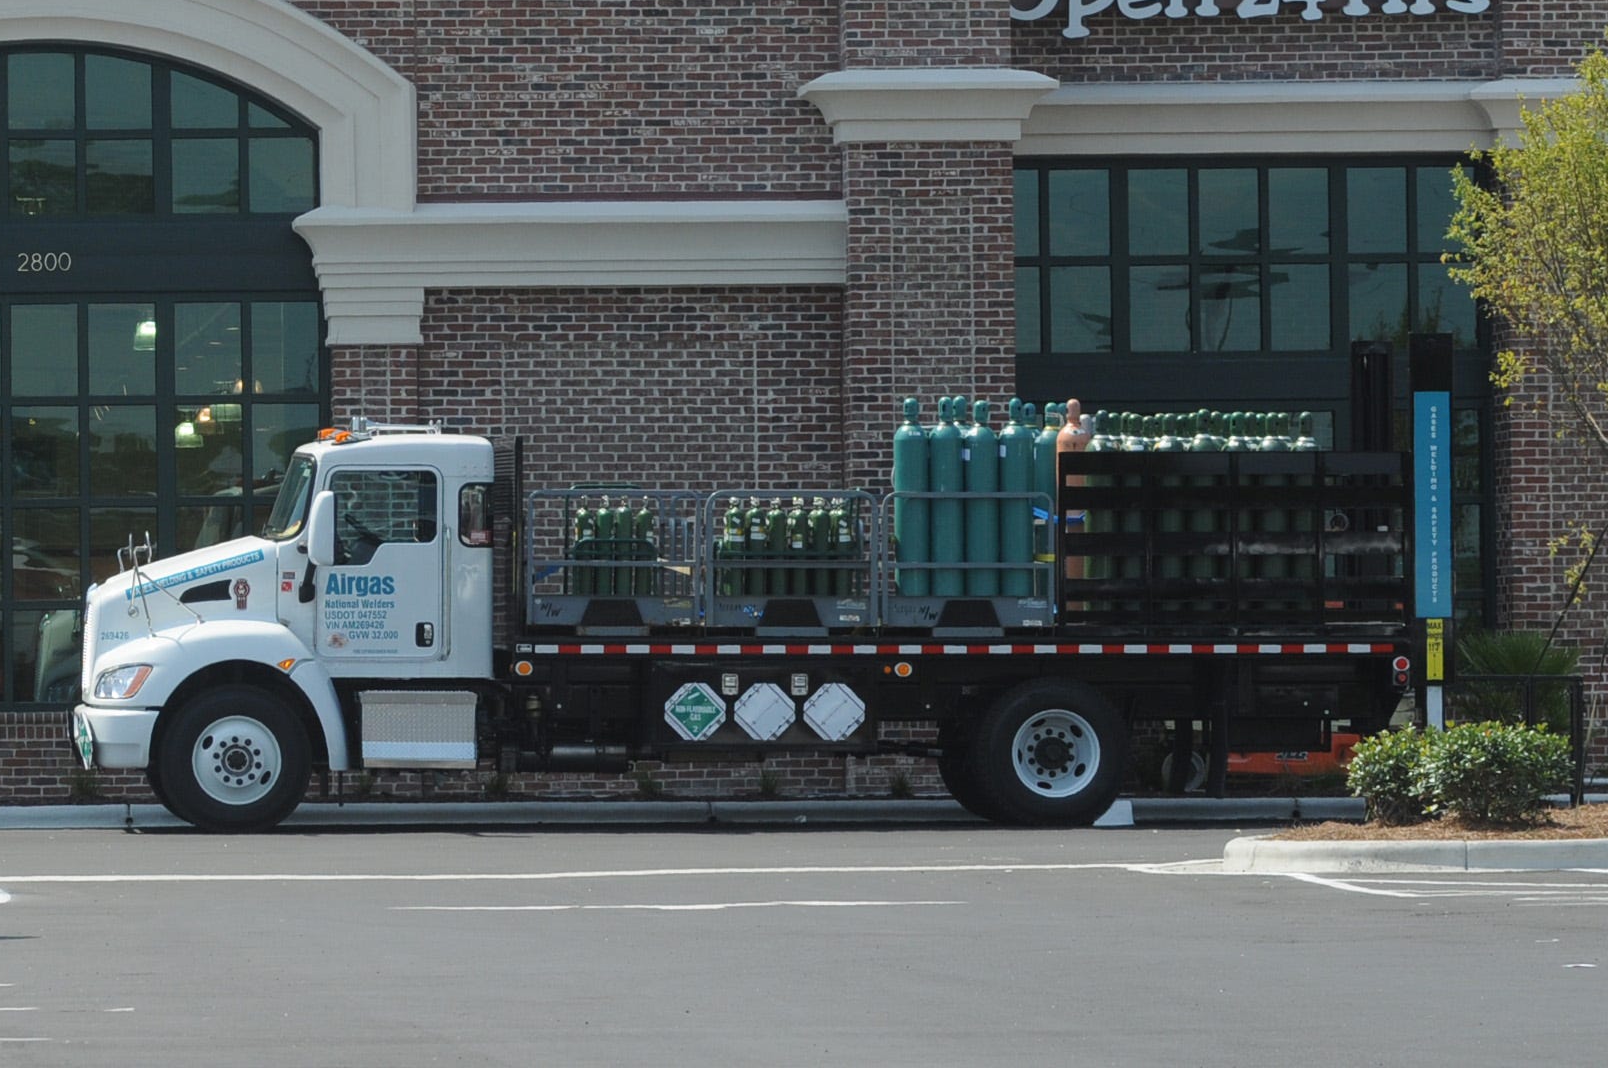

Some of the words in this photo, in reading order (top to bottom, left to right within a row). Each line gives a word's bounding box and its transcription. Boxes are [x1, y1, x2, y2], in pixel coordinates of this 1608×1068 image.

[17, 252, 72, 272] 2800
[1430, 445, 1438, 490] WELDING
[222, 552, 260, 570] PRODUCTS
[325, 573, 395, 597] Airgas
[325, 599, 359, 608] National
[361, 599, 395, 608] Welders
[325, 611, 355, 620] USDOT
[357, 611, 387, 620] 047552
[325, 621, 340, 630] VIN
[348, 630, 369, 639] GVW
